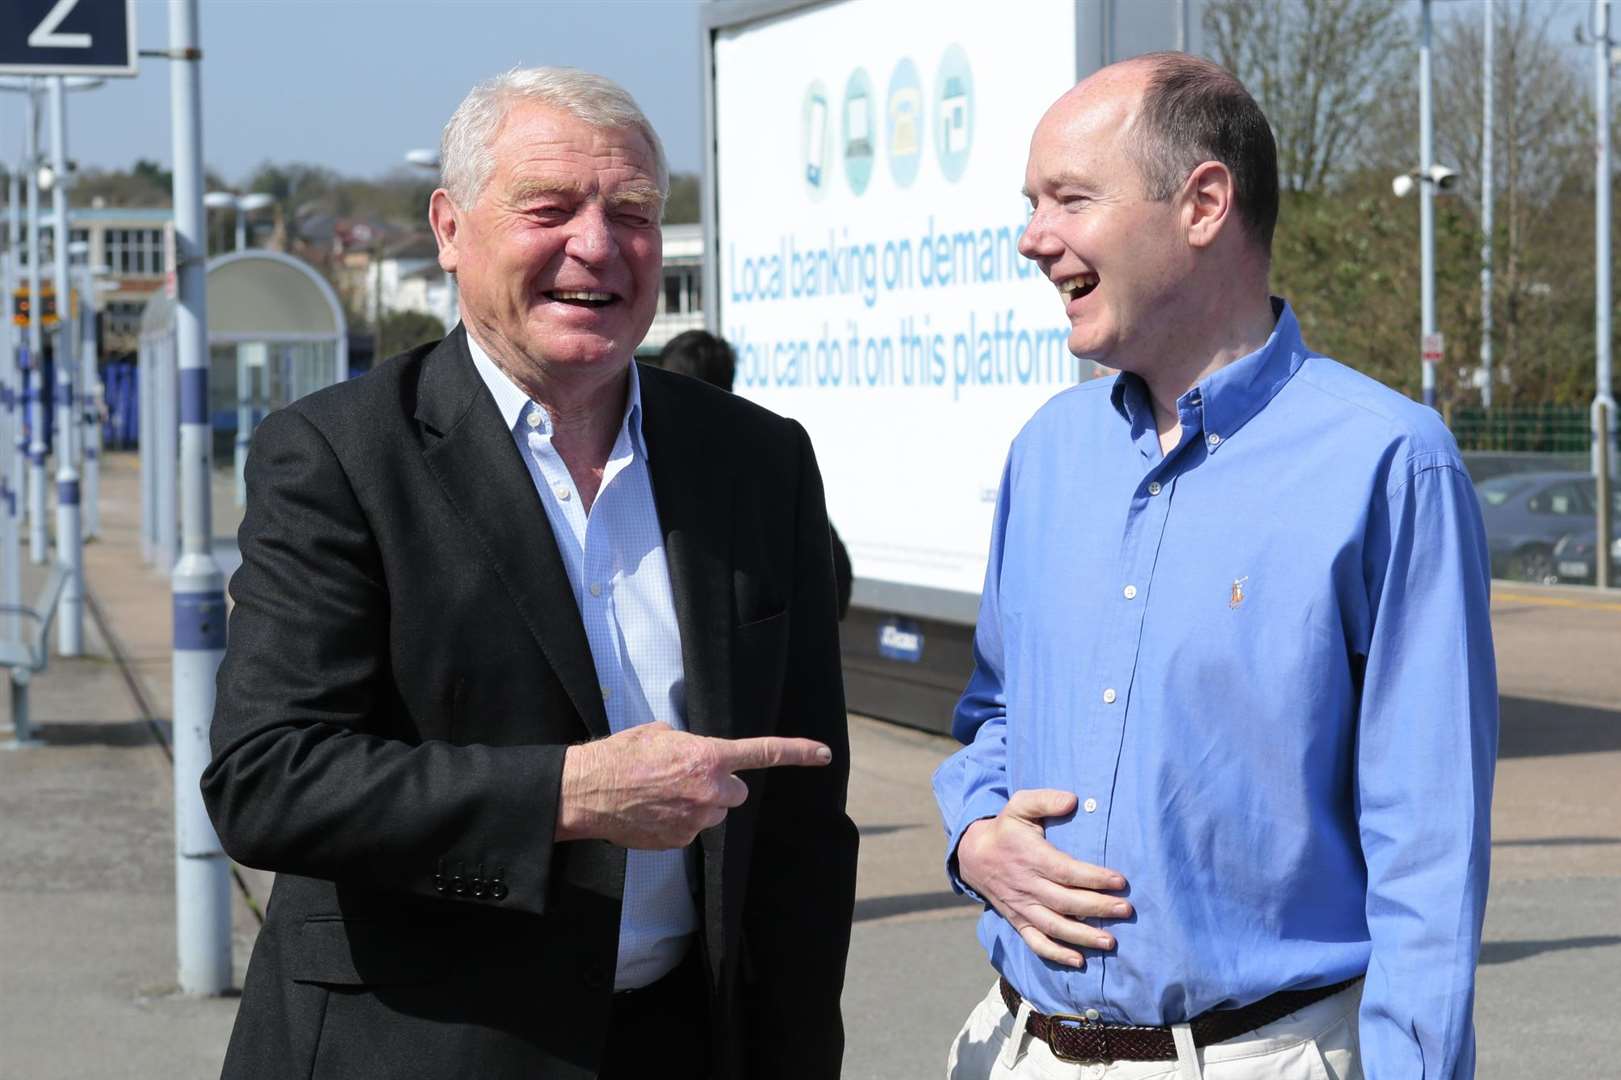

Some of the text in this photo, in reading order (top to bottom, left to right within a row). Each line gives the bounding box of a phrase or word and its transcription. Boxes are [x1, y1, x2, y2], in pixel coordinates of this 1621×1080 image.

[730, 235, 786, 303] Local
[790, 226, 876, 310] banking
[882, 238, 914, 291] on
[730, 324, 769, 388] You
[773, 340, 812, 388] can
[814, 319, 844, 388] do
[846, 318, 860, 388] it
[864, 336, 895, 387] on
[900, 312, 946, 386] this
